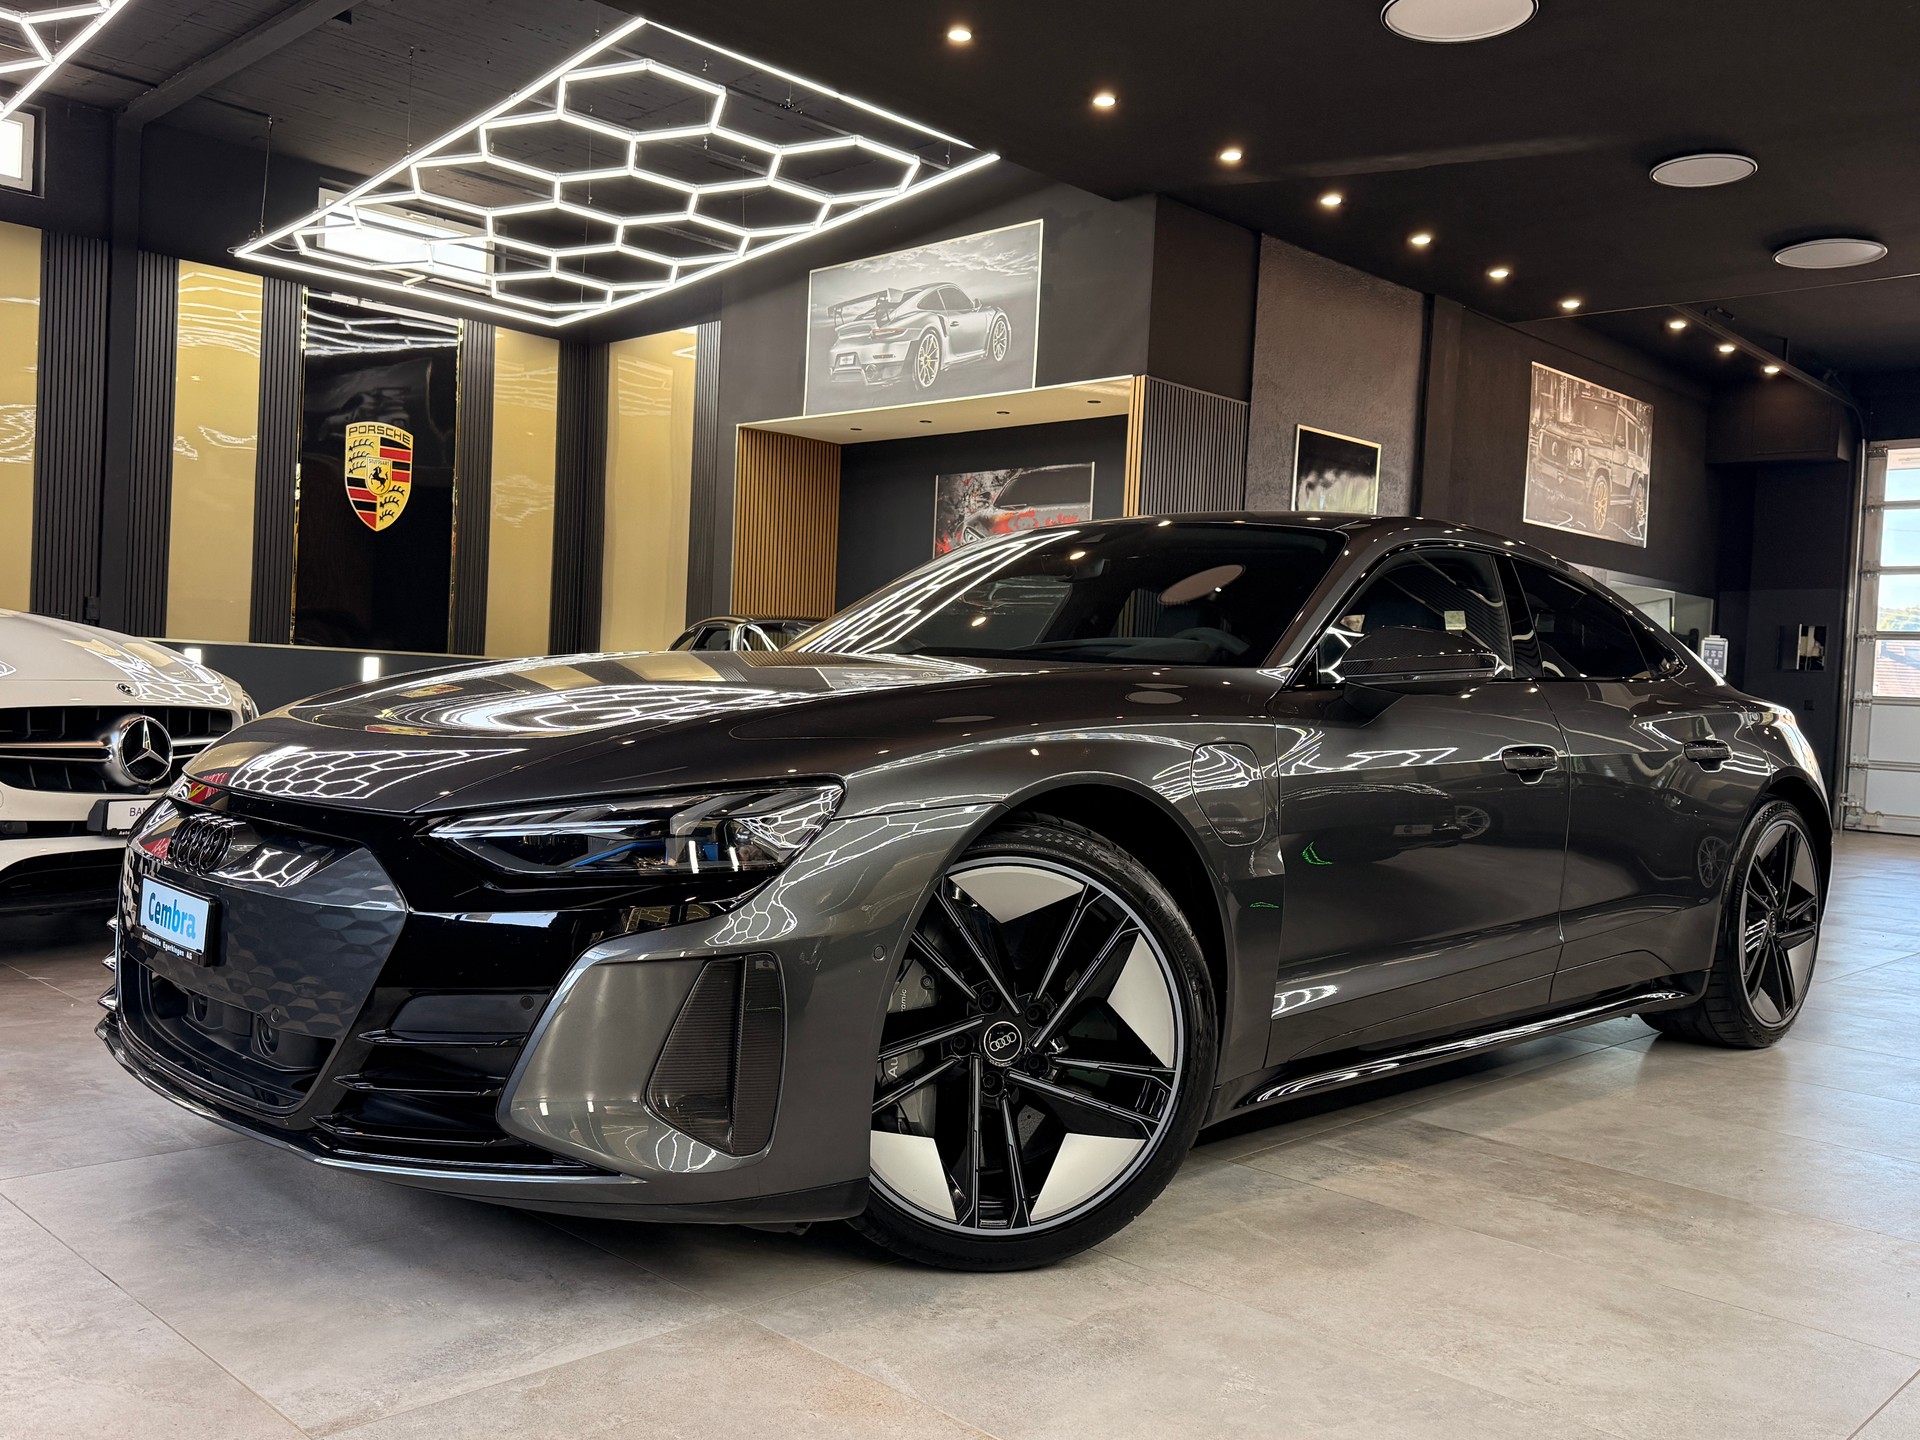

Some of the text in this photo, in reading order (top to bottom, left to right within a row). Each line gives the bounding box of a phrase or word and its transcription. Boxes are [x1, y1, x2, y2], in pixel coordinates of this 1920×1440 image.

[349, 425, 410, 445] PORSCHE
[368, 458, 390, 466] STUTTGART
[148, 892, 196, 939] Cembra
[141, 931, 193, 960] Automobile Egerkingen AG
